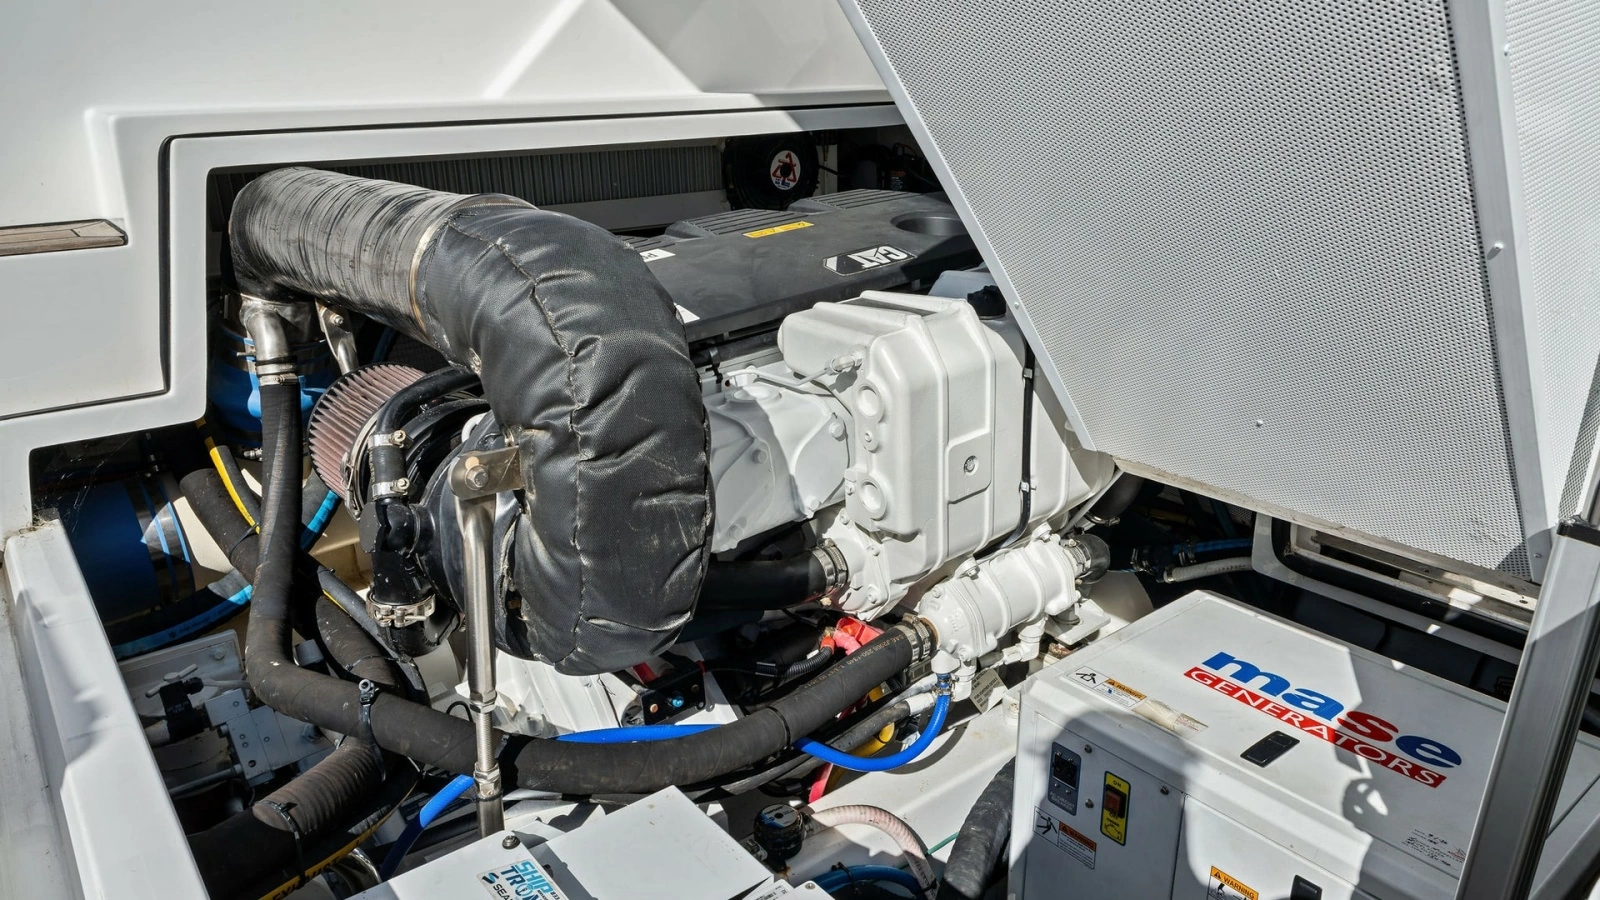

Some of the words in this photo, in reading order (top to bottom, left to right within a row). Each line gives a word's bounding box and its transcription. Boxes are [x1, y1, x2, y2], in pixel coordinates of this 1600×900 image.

[848, 246, 908, 269] CAT
[1202, 652, 1462, 768] mase
[1190, 669, 1442, 787] GENERATORS
[1113, 780, 1122, 788] ON
[518, 860, 553, 894] SHIP
[1223, 876, 1255, 899] WARNING
[493, 884, 513, 900] SEA
